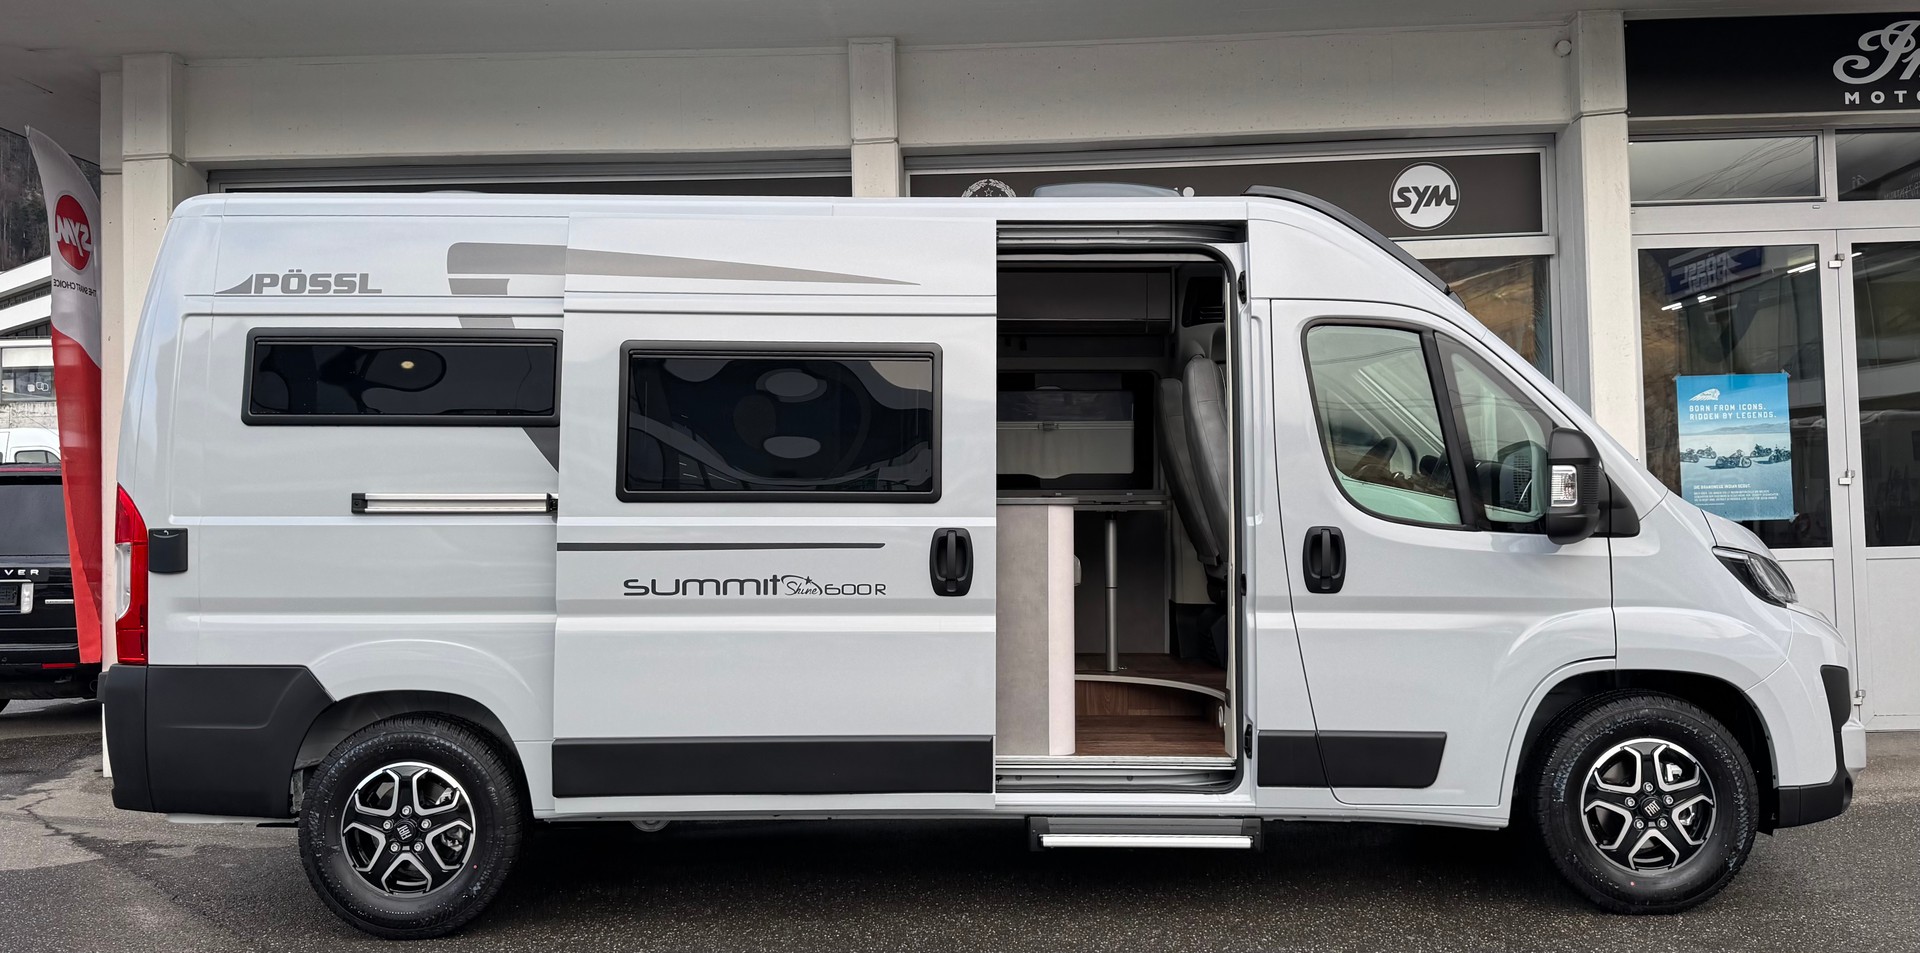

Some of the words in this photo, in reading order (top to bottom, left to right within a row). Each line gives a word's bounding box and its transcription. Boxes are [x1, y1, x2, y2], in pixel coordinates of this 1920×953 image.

[1844, 90, 1920, 105] MOT
[1393, 185, 1457, 214] SYM
[253, 268, 383, 294] PÖSSL
[1689, 404, 1711, 412] BORN
[1739, 403, 1766, 411] ICONS.
[1736, 411, 1777, 419] LEGENDS.
[782, 576, 822, 596] Shine
[1644, 800, 1660, 817] FIAT
